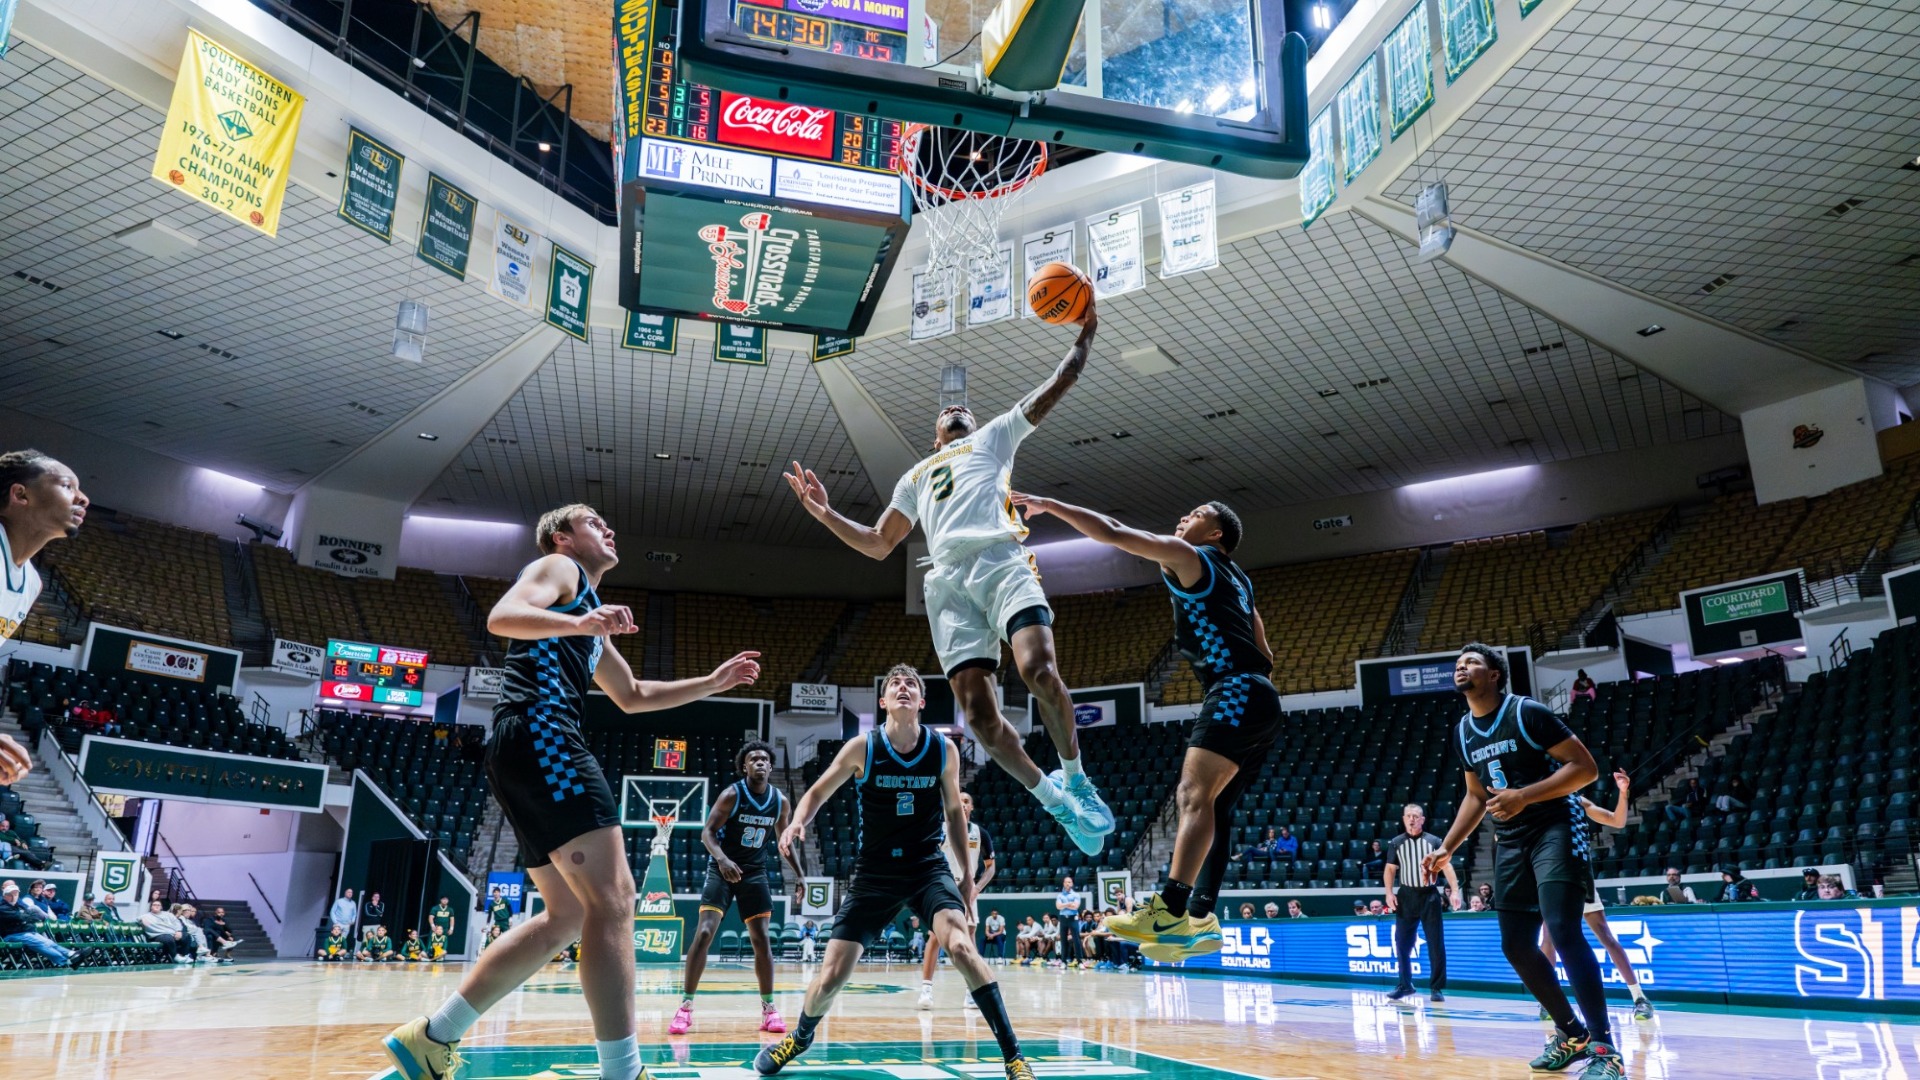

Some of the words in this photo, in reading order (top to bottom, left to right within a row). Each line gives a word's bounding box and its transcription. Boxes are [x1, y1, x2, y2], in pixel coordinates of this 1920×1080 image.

[864, 4, 904, 19] MONTH
[754, 10, 824, 46] 14:30
[866, 30, 880, 43] MC
[658, 41, 670, 49] NO
[833, 42, 842, 54] 2
[662, 50, 673, 66] 0
[201, 41, 292, 103] SOUTHEASTERN
[620, 0, 649, 138] SOUTHEASTERN
[662, 67, 671, 83] 3
[209, 62, 241, 86] LADY
[245, 82, 279, 110] LIONS
[204, 76, 277, 126] BASKETBALL
[660, 84, 669, 100] 5
[676, 86, 685, 102] 3
[700, 91, 709, 107] 5
[660, 102, 669, 118] 7
[673, 104, 683, 120] 0
[699, 108, 709, 124] 3
[724, 97, 831, 140] Coca-Cola
[647, 117, 667, 134] 23
[693, 124, 707, 140] 16
[853, 116, 862, 132] 5
[892, 123, 900, 137] 3
[183, 120, 235, 156] 1976-77
[238, 153, 274, 179] AIAW
[843, 132, 862, 149] 20
[892, 139, 900, 155] 3
[190, 143, 258, 189] NATIONAL
[360, 145, 393, 173] SLU
[647, 144, 677, 174] MP
[842, 150, 861, 166] 32
[178, 156, 262, 208] CHAMPIONS
[350, 170, 395, 198] Basketball
[354, 162, 393, 189] Women's
[817, 181, 833, 190] Fuel
[836, 183, 847, 191] for
[849, 186, 863, 195] our
[1181, 190, 1193, 203] S
[201, 186, 234, 211] 30-2
[434, 209, 467, 232] Women's
[1107, 212, 1119, 226] S
[1165, 204, 1211, 221] Southeastern
[1172, 212, 1204, 225] Women's
[429, 214, 469, 241] Basketball
[1170, 218, 1205, 231] Volleyball
[504, 223, 529, 246] SLU
[1043, 231, 1056, 245] S
[1092, 227, 1137, 245] Southeastern
[1099, 235, 1130, 247] Women's
[1172, 234, 1201, 247] SLC
[501, 240, 530, 261] Women's
[1028, 246, 1070, 262] Southeastern
[1098, 240, 1131, 254] Volleyball
[435, 251, 454, 267] 2023
[803, 228, 822, 284] TANGIPAHOA
[1179, 250, 1198, 262] 2024
[754, 228, 800, 308] Crossroads
[565, 285, 576, 299] 21
[783, 286, 813, 313] PARISH
[634, 333, 646, 341] C.A.
[647, 334, 665, 343] CORE
[931, 464, 954, 502] 3
[1313, 518, 1343, 530] Gate
[1347, 515, 1353, 525] 1
[318, 534, 383, 556] RONNIE'S
[314, 560, 341, 571] Boudin
[350, 565, 379, 576] Cracklin
[1706, 586, 1776, 608] COURTYARD
[1726, 599, 1763, 613] Marriott
[280, 641, 321, 658] RONNIE'S
[333, 665, 349, 677] 66
[362, 663, 393, 676] 14:30
[1422, 672, 1454, 680] GUARANTY
[378, 677, 385, 686] 2
[404, 673, 419, 685] 42
[800, 685, 829, 696] S&W
[802, 698, 827, 706] FOODS
[1471, 739, 1518, 763] CHOCTAWS
[665, 752, 680, 768] 12
[875, 774, 937, 789] CHOCTAWS
[1488, 759, 1509, 789] 5
[896, 791, 915, 816] 2
[738, 813, 776, 826] CHOCTAWS
[740, 826, 767, 849] 20
[108, 866, 126, 885] S
[812, 887, 825, 902] S
[1221, 927, 1272, 956] SLC
[1221, 956, 1272, 969] SOUTHLAND
[1349, 960, 1422, 974] SOUTHLAD
